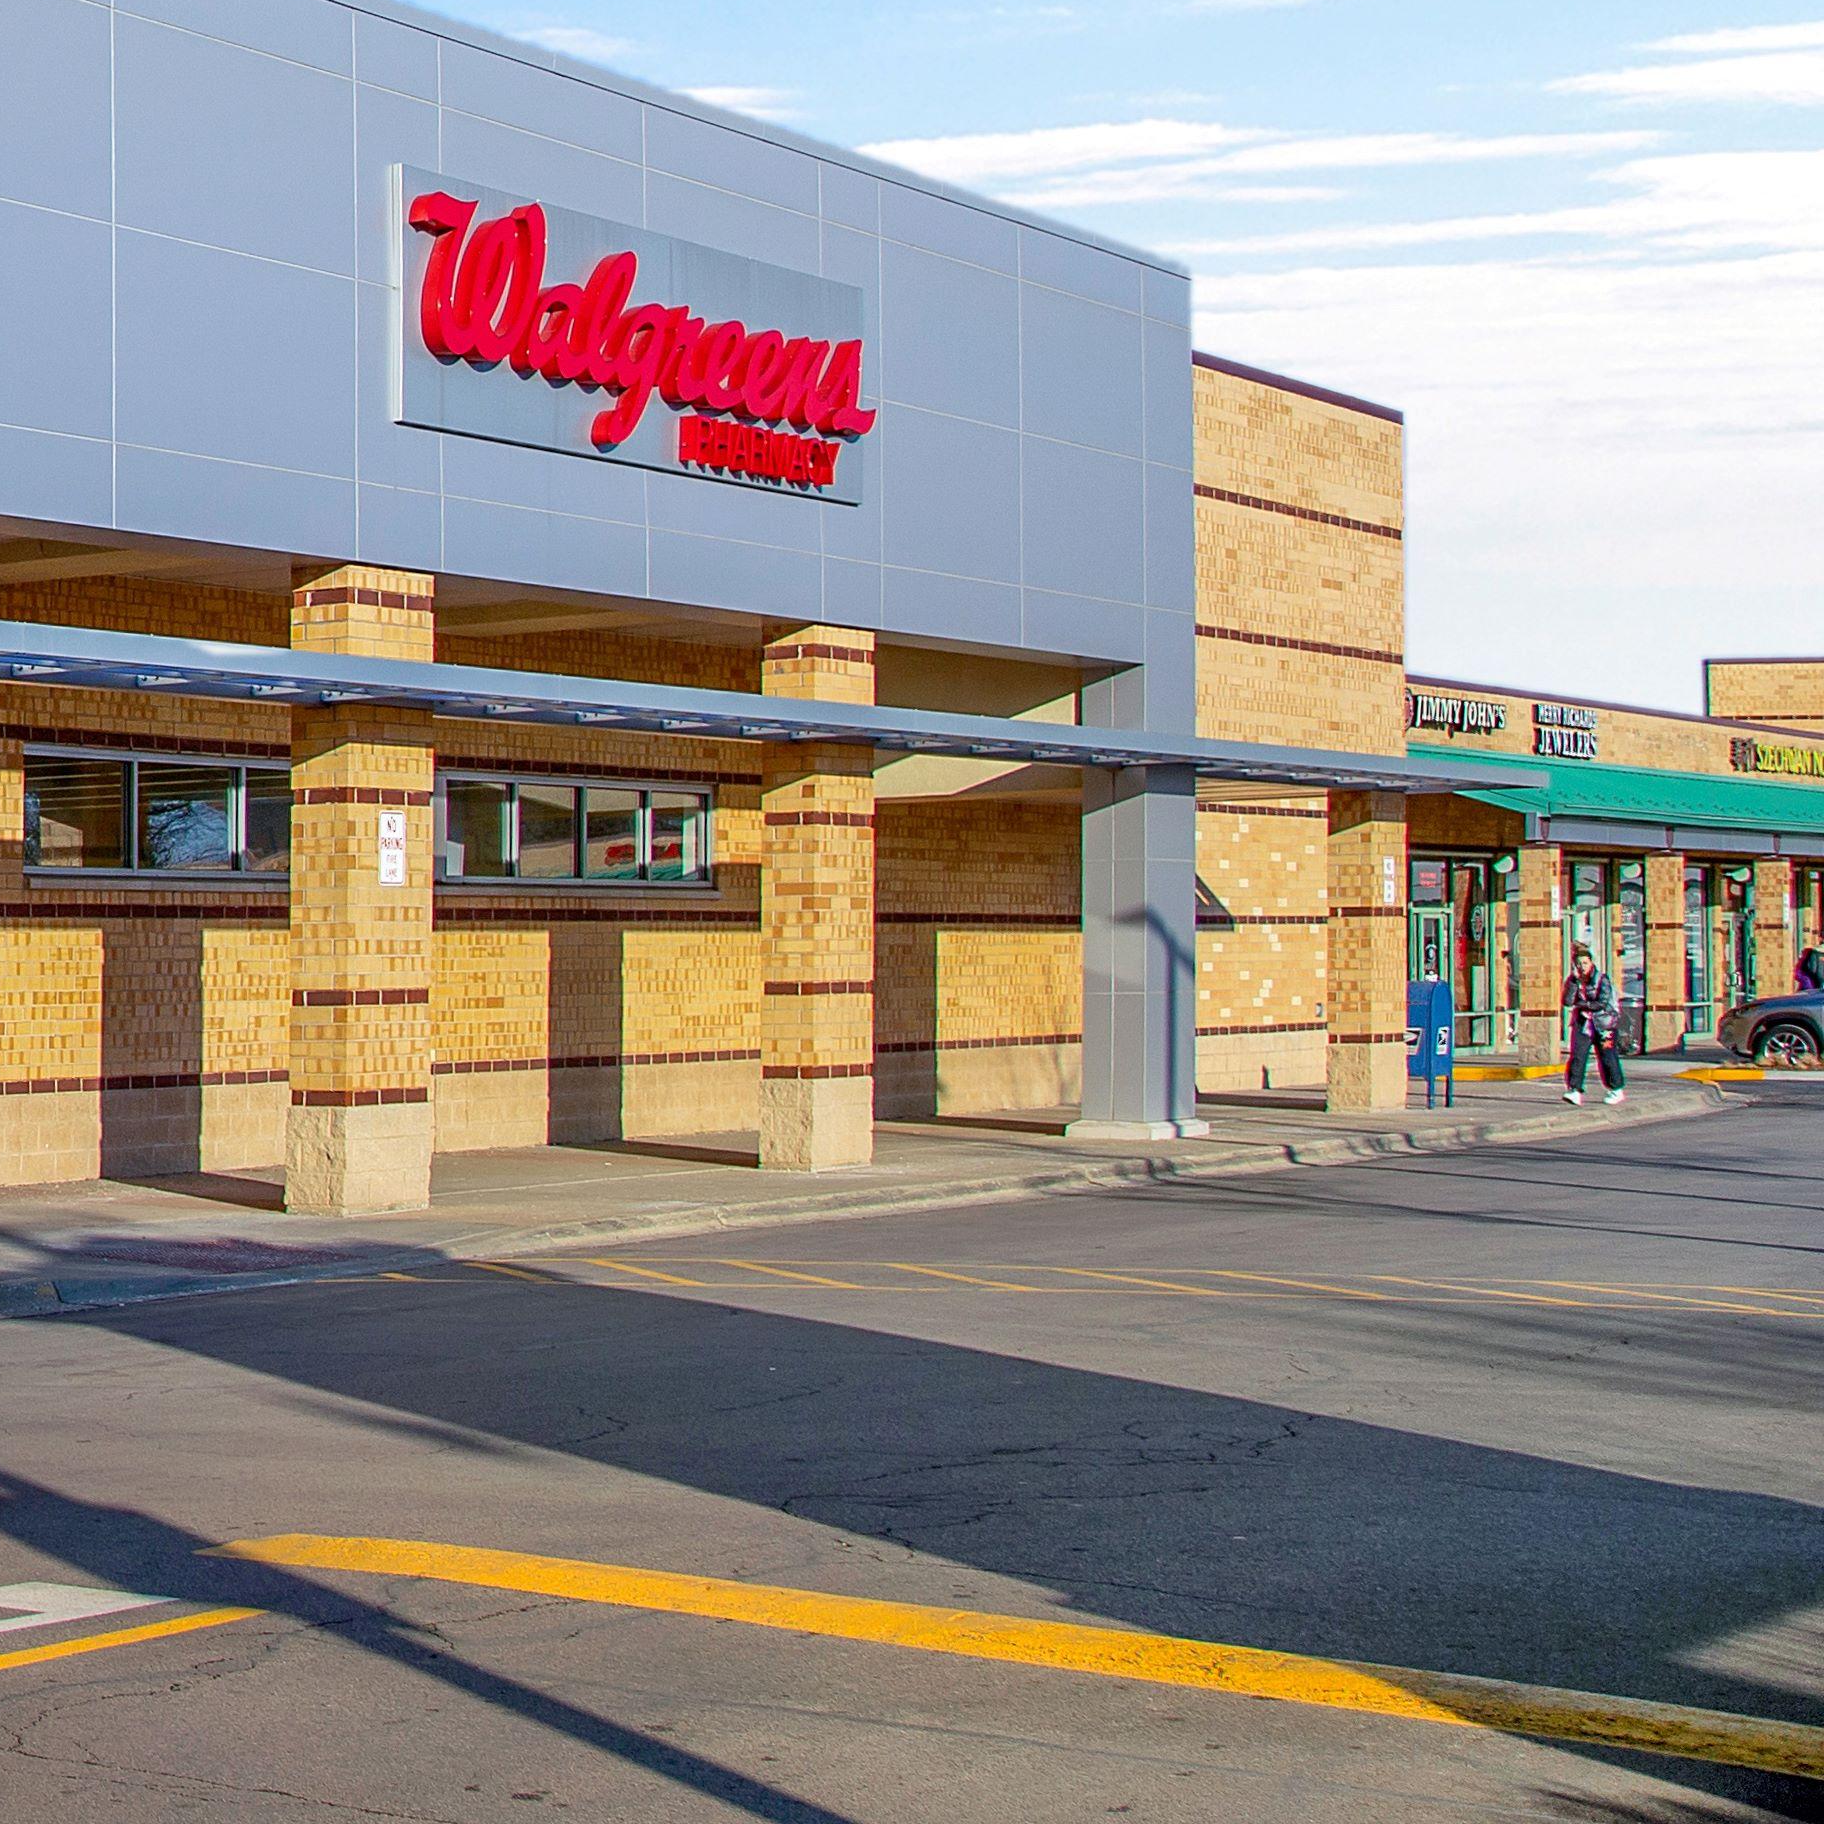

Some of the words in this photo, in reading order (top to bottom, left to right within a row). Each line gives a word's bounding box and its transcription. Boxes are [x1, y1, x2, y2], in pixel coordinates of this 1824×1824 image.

[408, 190, 877, 451] Walgreens
[678, 414, 842, 488] PHARMACY
[1415, 695, 1462, 727] JIMMY
[1462, 701, 1506, 732] JOHN'S
[1538, 728, 1599, 759] JEWELERS
